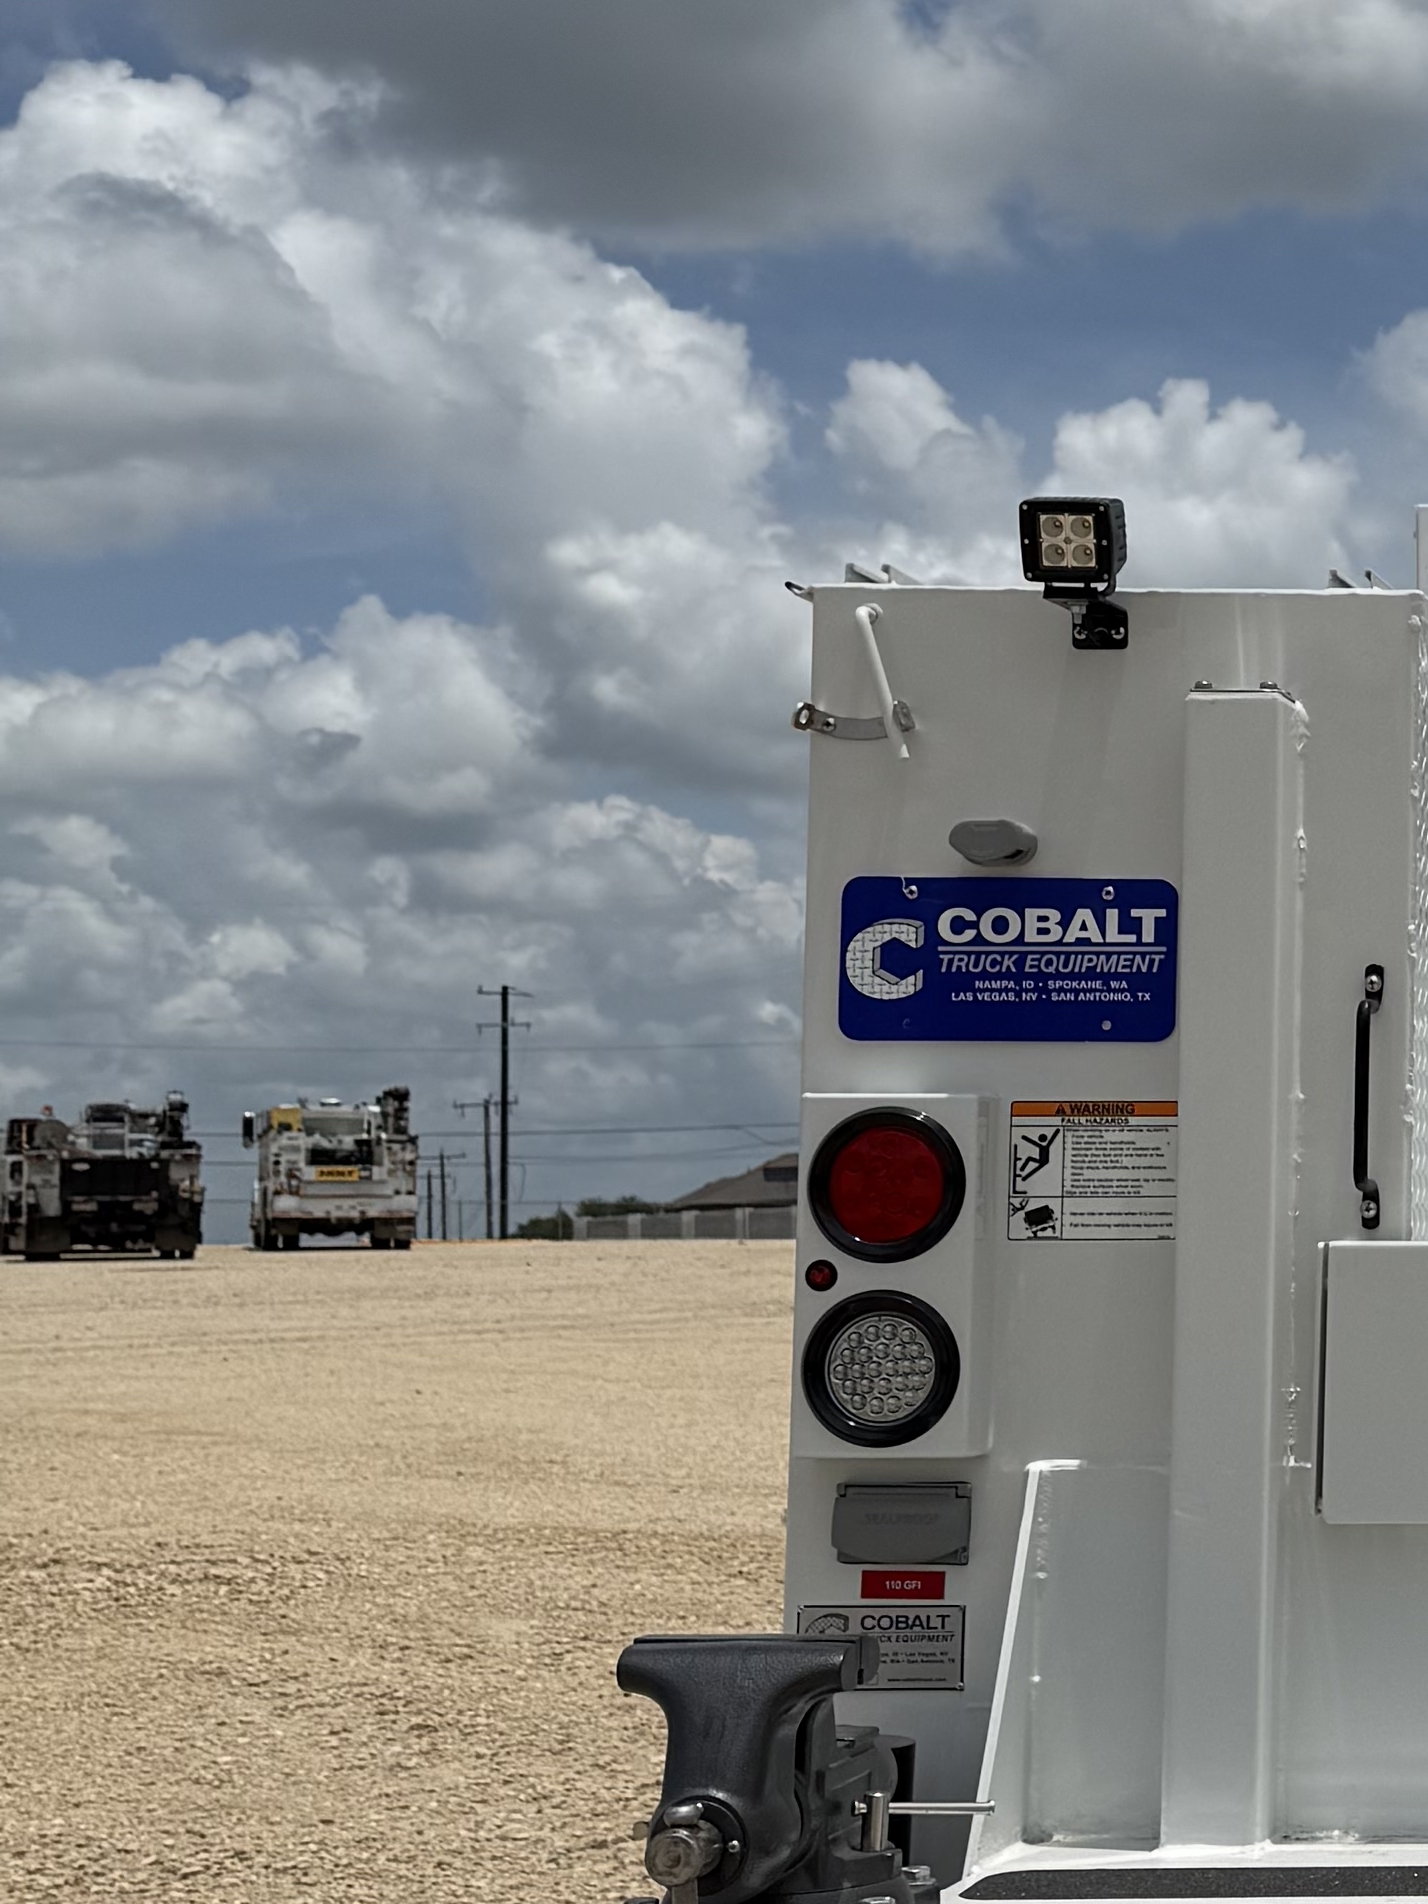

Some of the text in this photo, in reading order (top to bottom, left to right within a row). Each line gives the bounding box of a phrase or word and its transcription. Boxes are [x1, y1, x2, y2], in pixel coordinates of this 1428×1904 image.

[937, 907, 1167, 944] COBALT
[939, 953, 1165, 974] TRUCK EQUIPMENT
[975, 980, 1128, 991] NAMPA, ID SPOKANE, WA
[951, 992, 1151, 1003] LAS VEGAS, NV SAN ANTONIO, TX
[1069, 1103, 1136, 1115] WARNING
[1061, 1117, 1130, 1125] FALL HAZARDS
[885, 1580, 922, 1590] 110 GFI
[860, 1614, 951, 1631] COBALT
[895, 1634, 956, 1643] EQUIPMENT
